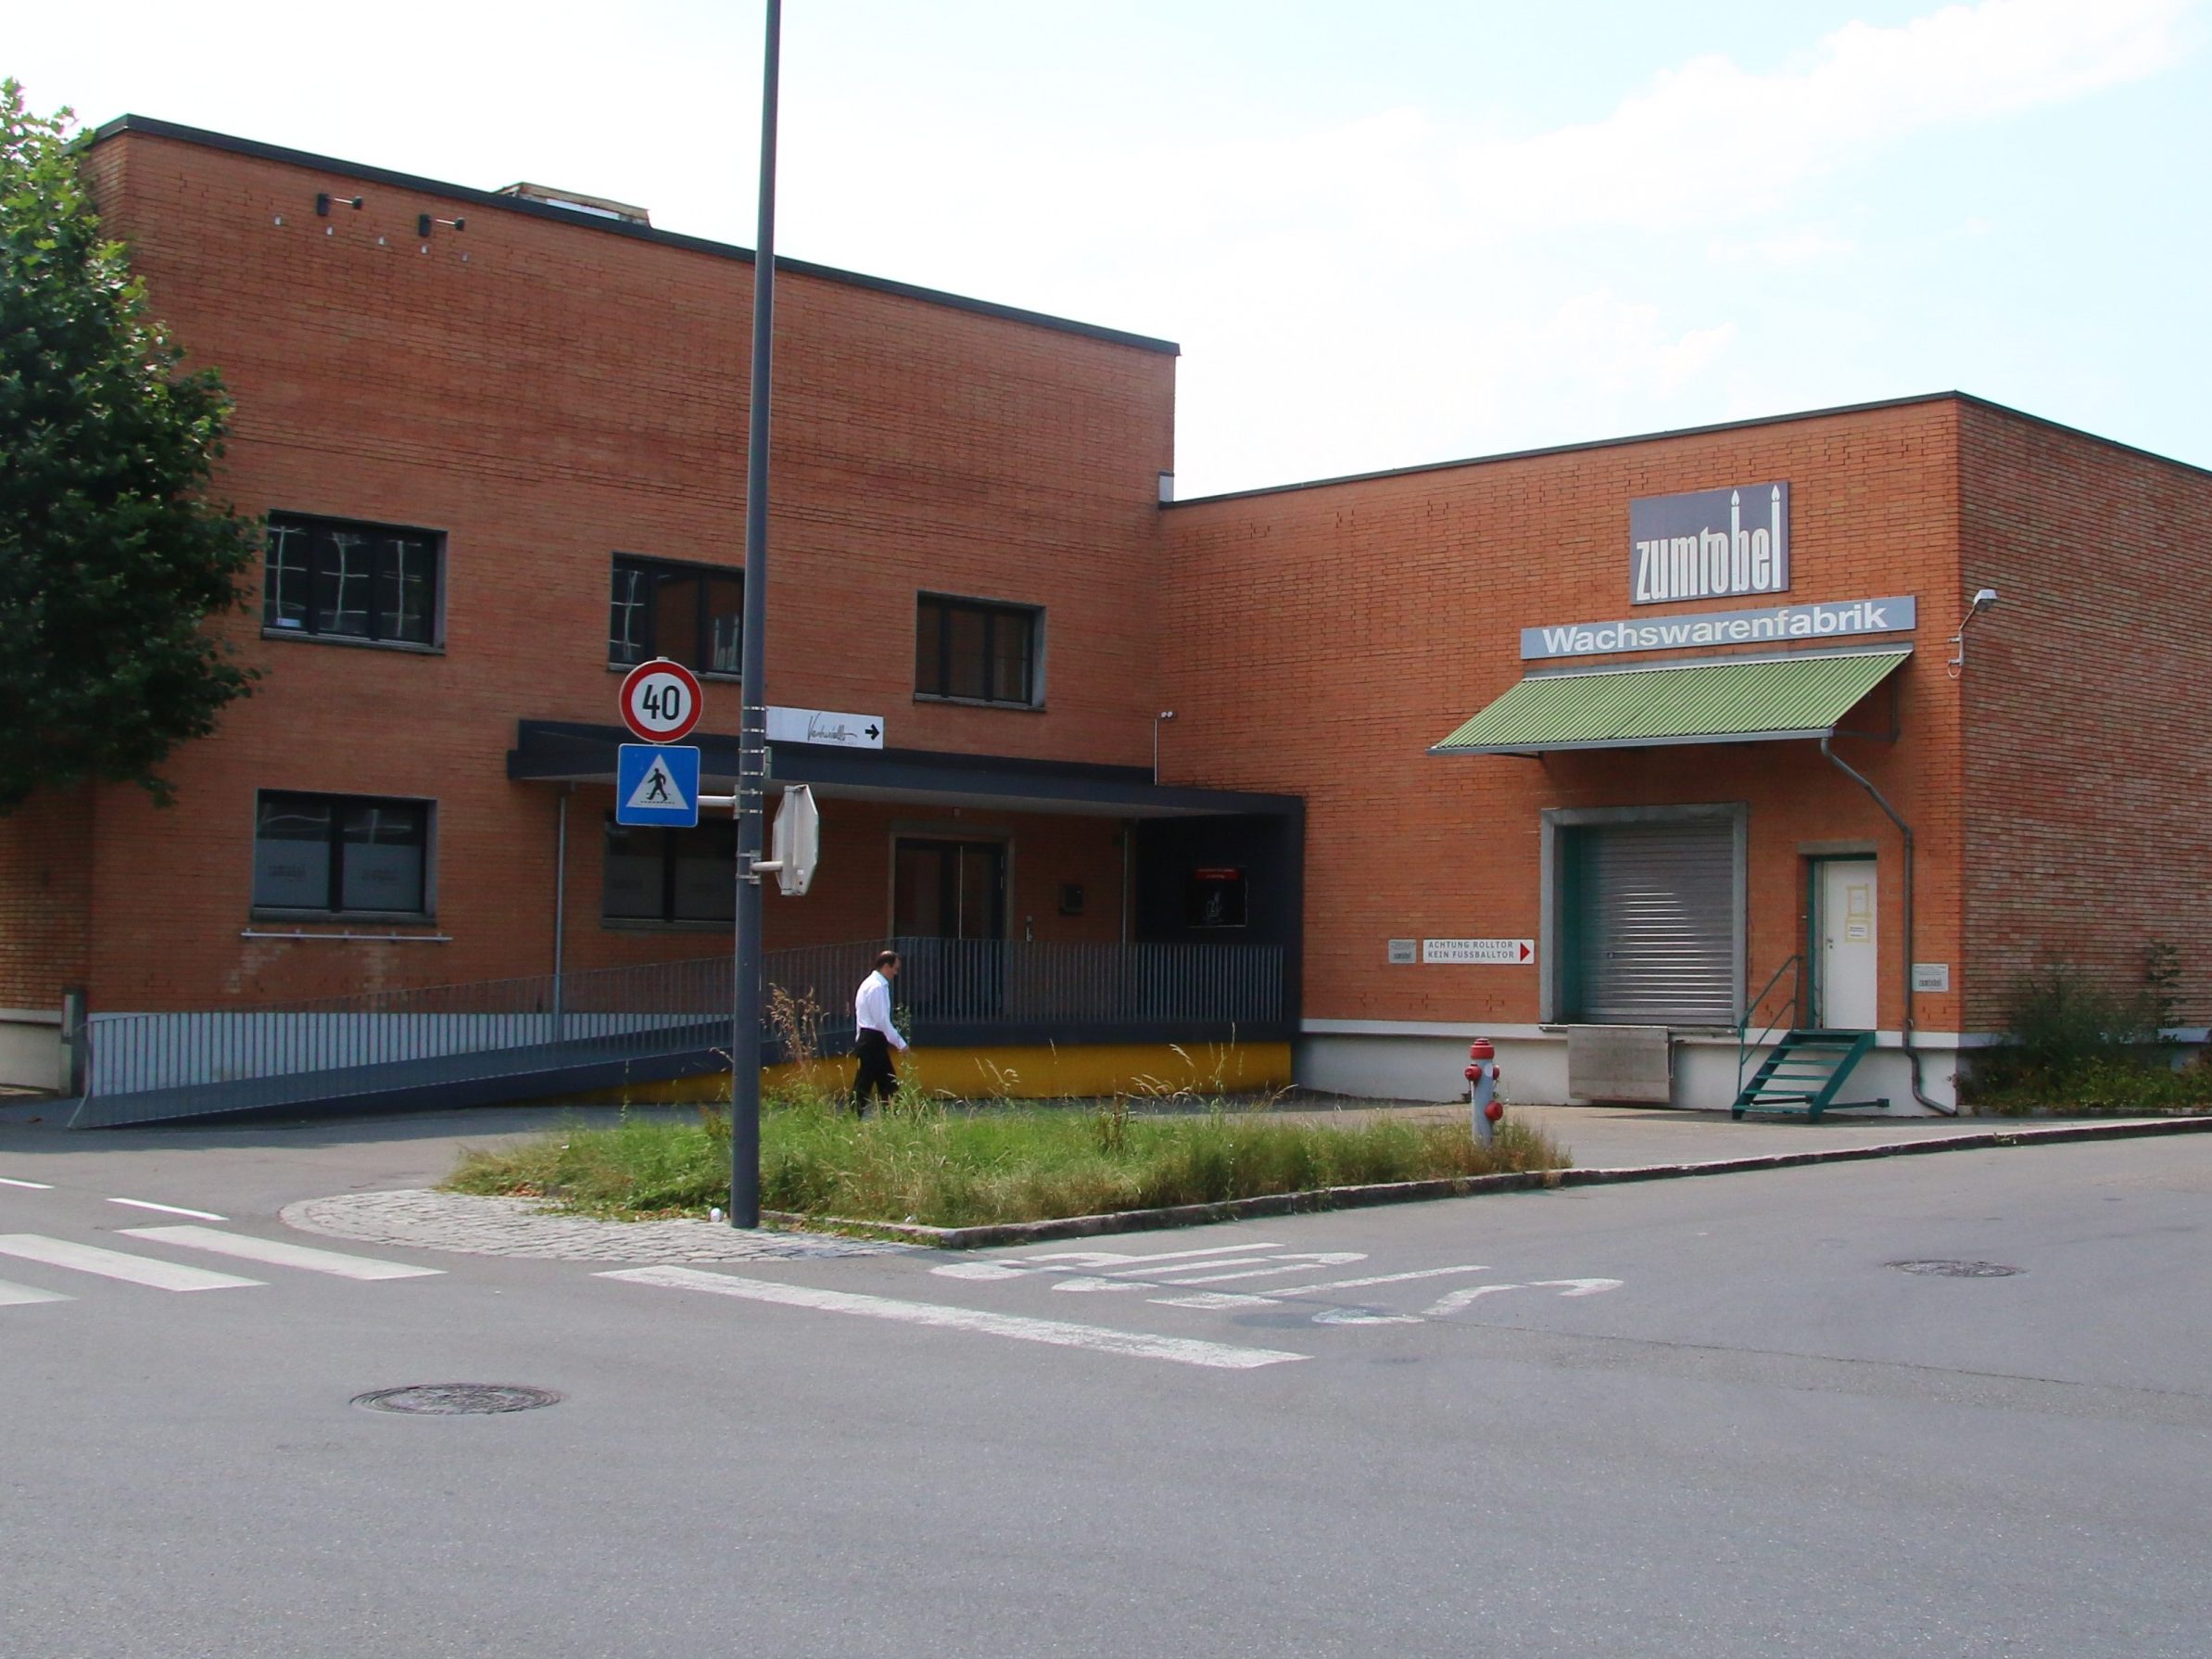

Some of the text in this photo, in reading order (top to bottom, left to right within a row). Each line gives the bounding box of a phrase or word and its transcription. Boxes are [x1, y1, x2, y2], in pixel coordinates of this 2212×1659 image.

[1636, 486, 1781, 602] zumtobel
[1542, 603, 1890, 654] Wachswarenfabrik
[642, 684, 680, 721] 40
[1428, 950, 1514, 958] KEIN FUSSBALLTOR
[1429, 941, 1513, 949] ACHTUNG ROLLTOR
[928, 1242, 1624, 1325] STOP
